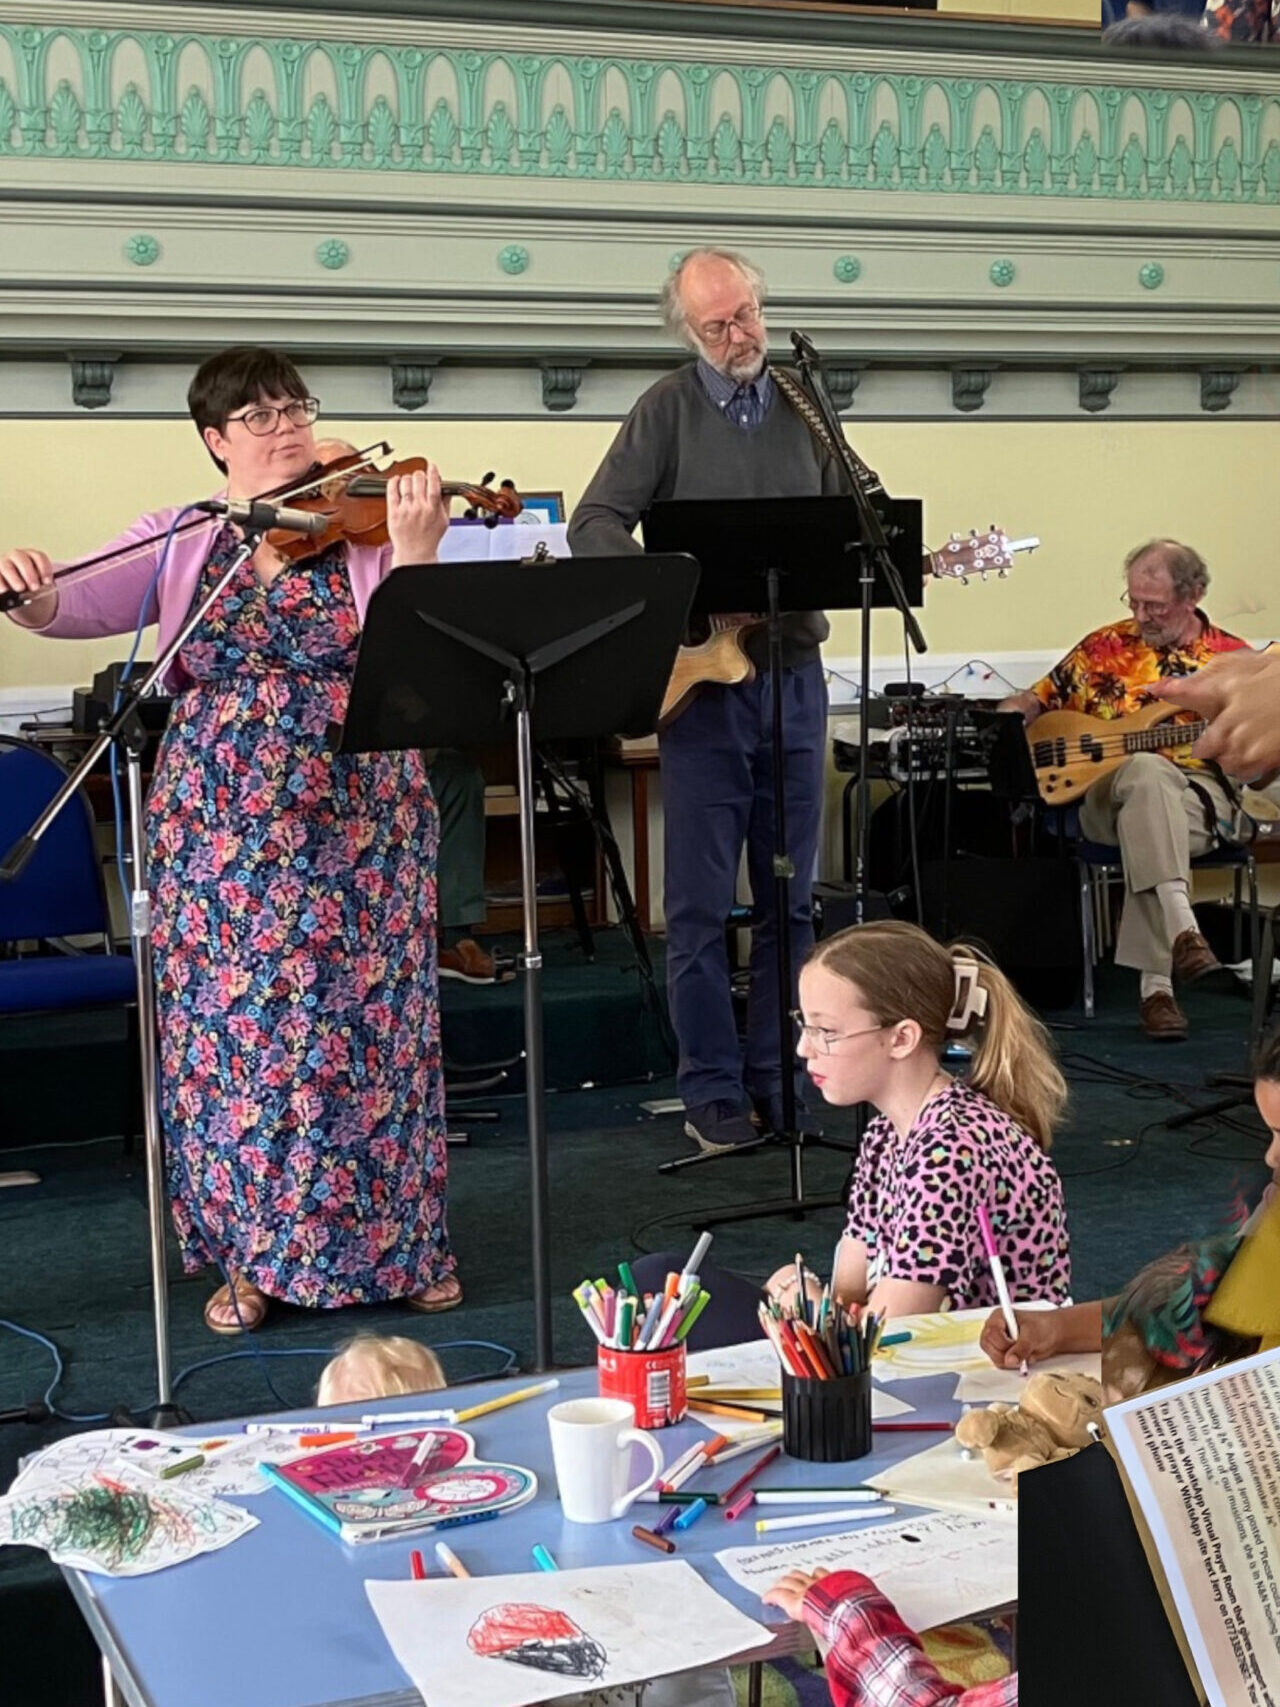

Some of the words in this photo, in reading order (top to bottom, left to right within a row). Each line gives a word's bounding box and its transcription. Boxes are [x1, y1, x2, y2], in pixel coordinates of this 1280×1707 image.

[1145, 1405, 1165, 1437] power
[1159, 1401, 1170, 1415] To
[1163, 1416, 1178, 1437] join
[1135, 1409, 1154, 1439] smart
[1146, 1439, 1166, 1473] phone
[1173, 1437, 1186, 1455] the
[1163, 1452, 1183, 1484] prayer
[1180, 1455, 1206, 1508] WhatsApp
[1178, 1485, 1202, 1537] WhatsApp
[1200, 1507, 1218, 1542] Virtual
[1196, 1537, 1209, 1556] site
[1210, 1541, 1228, 1574] Prayer
[1203, 1556, 1216, 1577] text
[1209, 1578, 1224, 1602] Jerry
[1222, 1574, 1238, 1604] Room
[1218, 1603, 1228, 1617] on
[1232, 1604, 1246, 1626] that
[1238, 1626, 1253, 1652] gives
